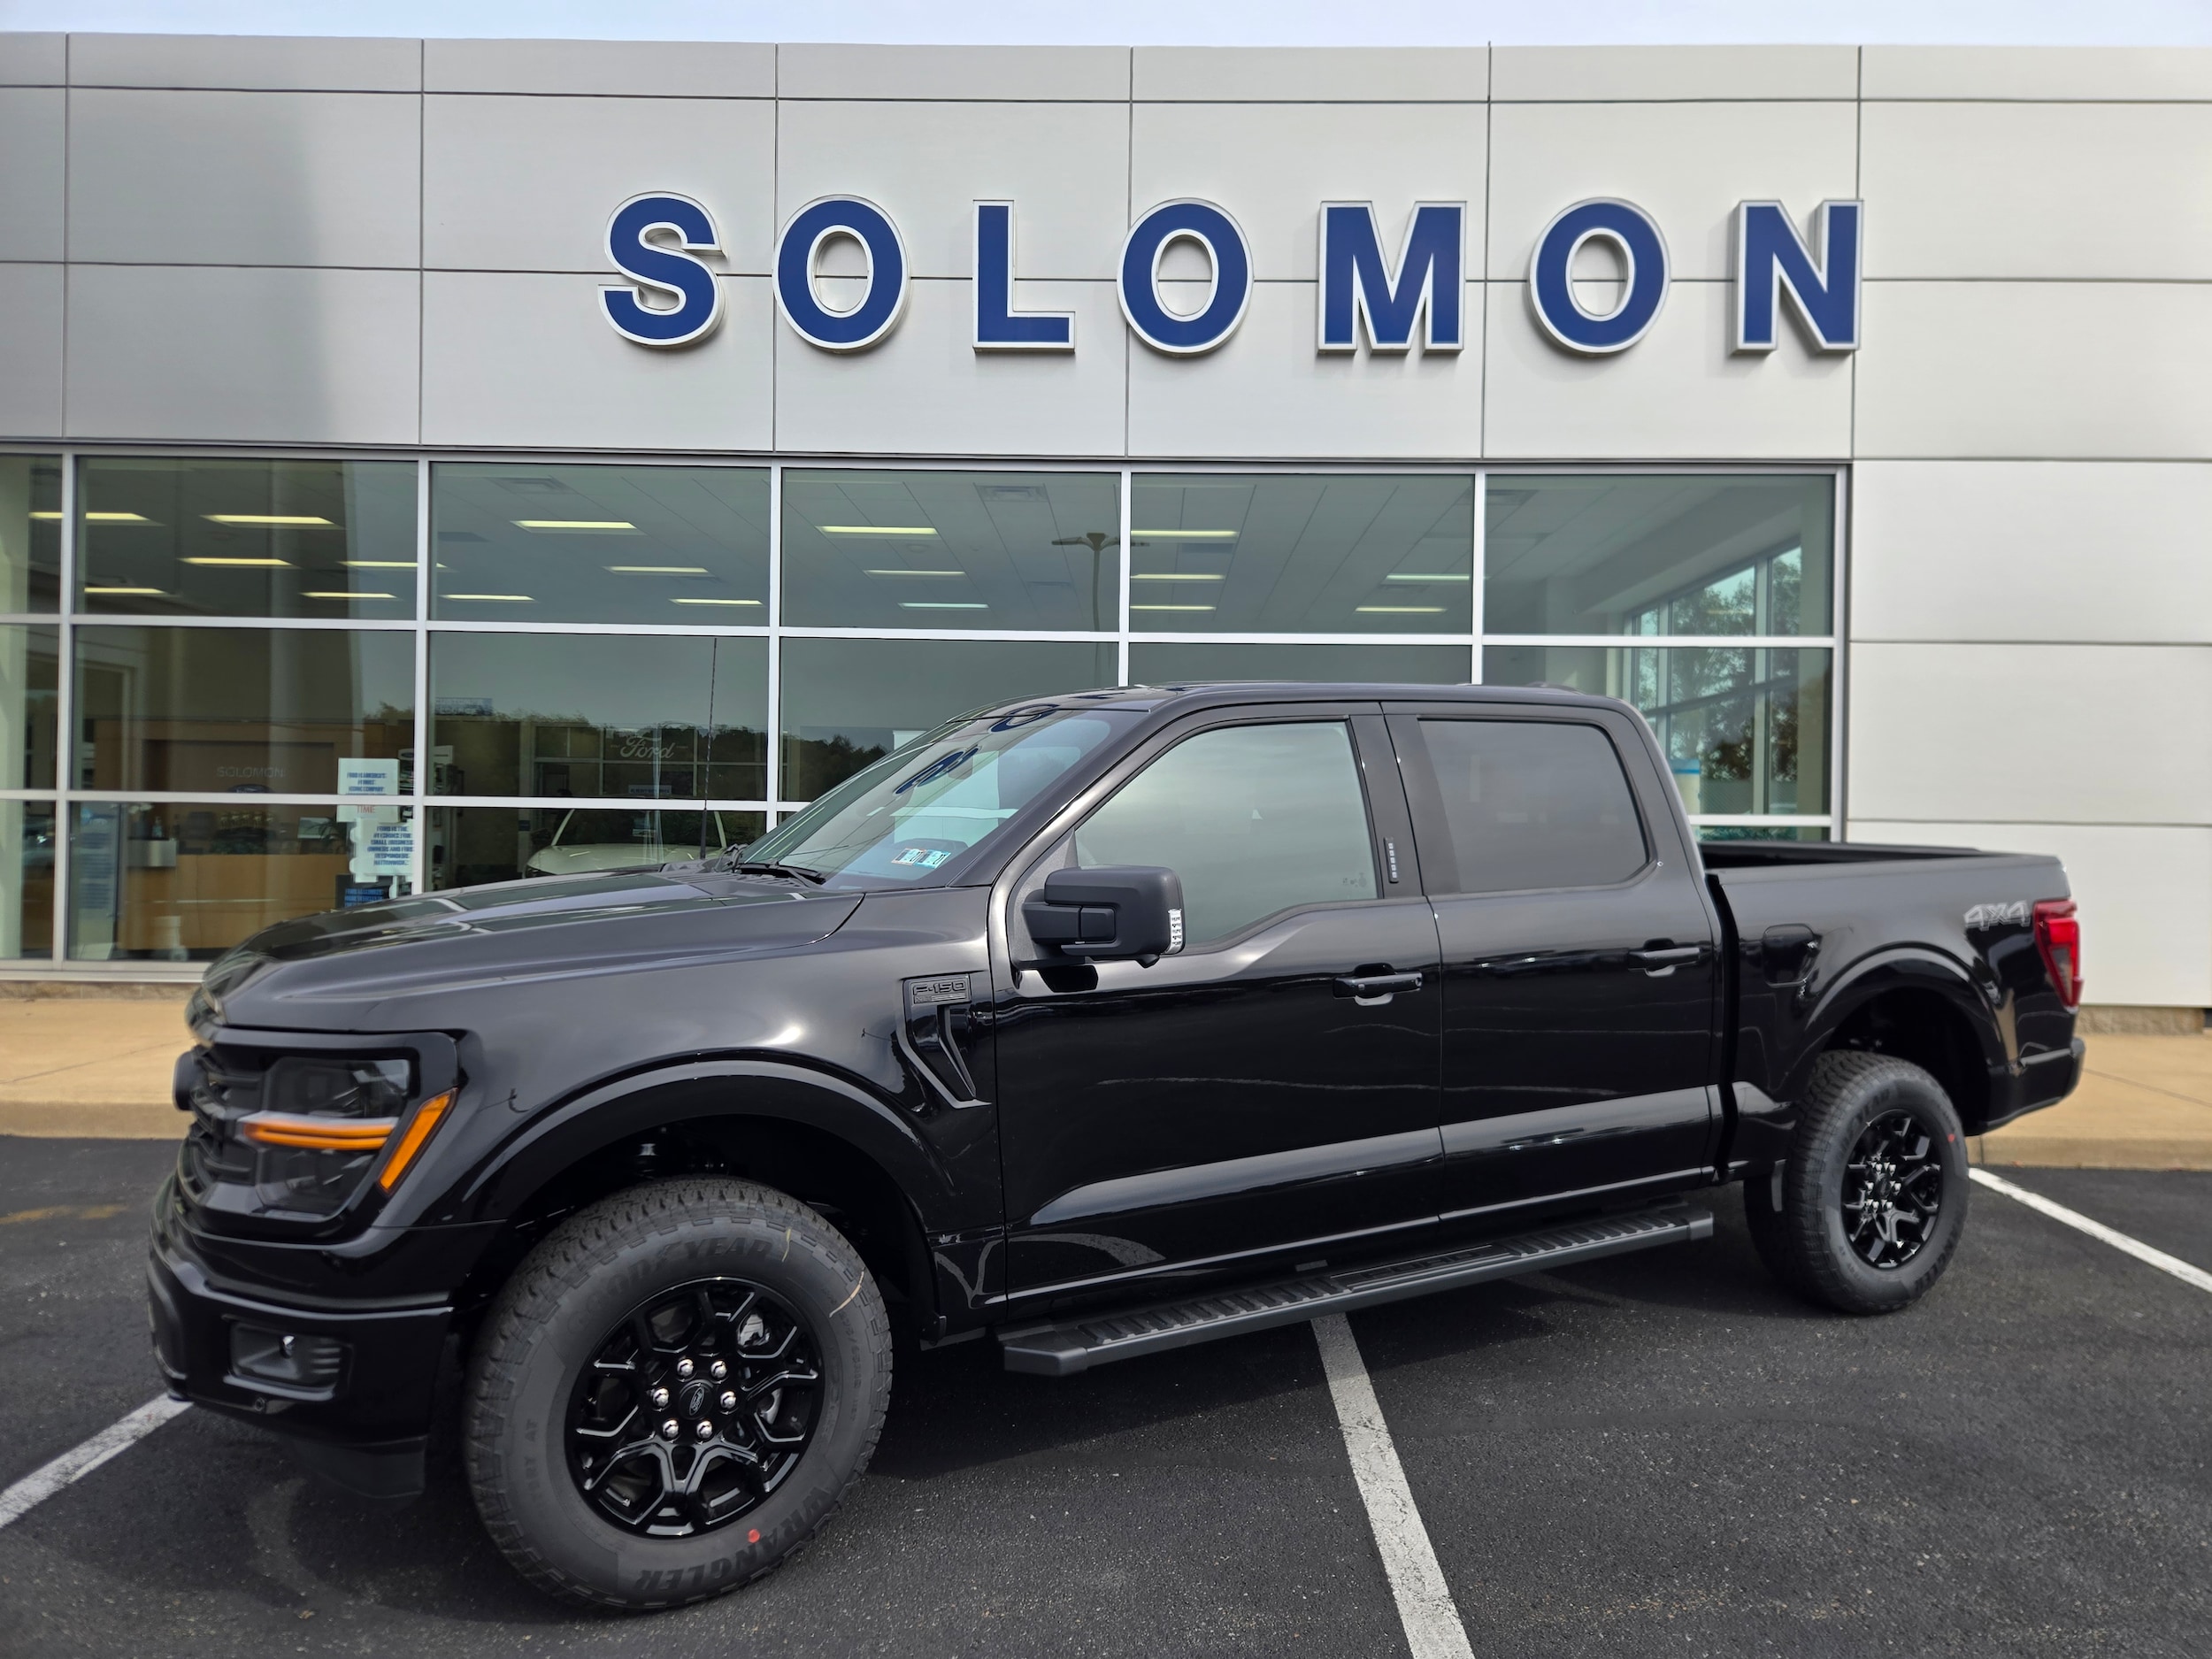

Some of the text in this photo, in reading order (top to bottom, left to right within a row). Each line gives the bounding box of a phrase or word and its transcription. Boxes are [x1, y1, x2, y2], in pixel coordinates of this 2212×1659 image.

[598, 190, 1863, 357] SOLOMON
[620, 736, 676, 759] Ford
[216, 765, 285, 778] SOLOMON
[912, 979, 966, 995] F-150
[634, 1486, 831, 1591] WRANGLER
